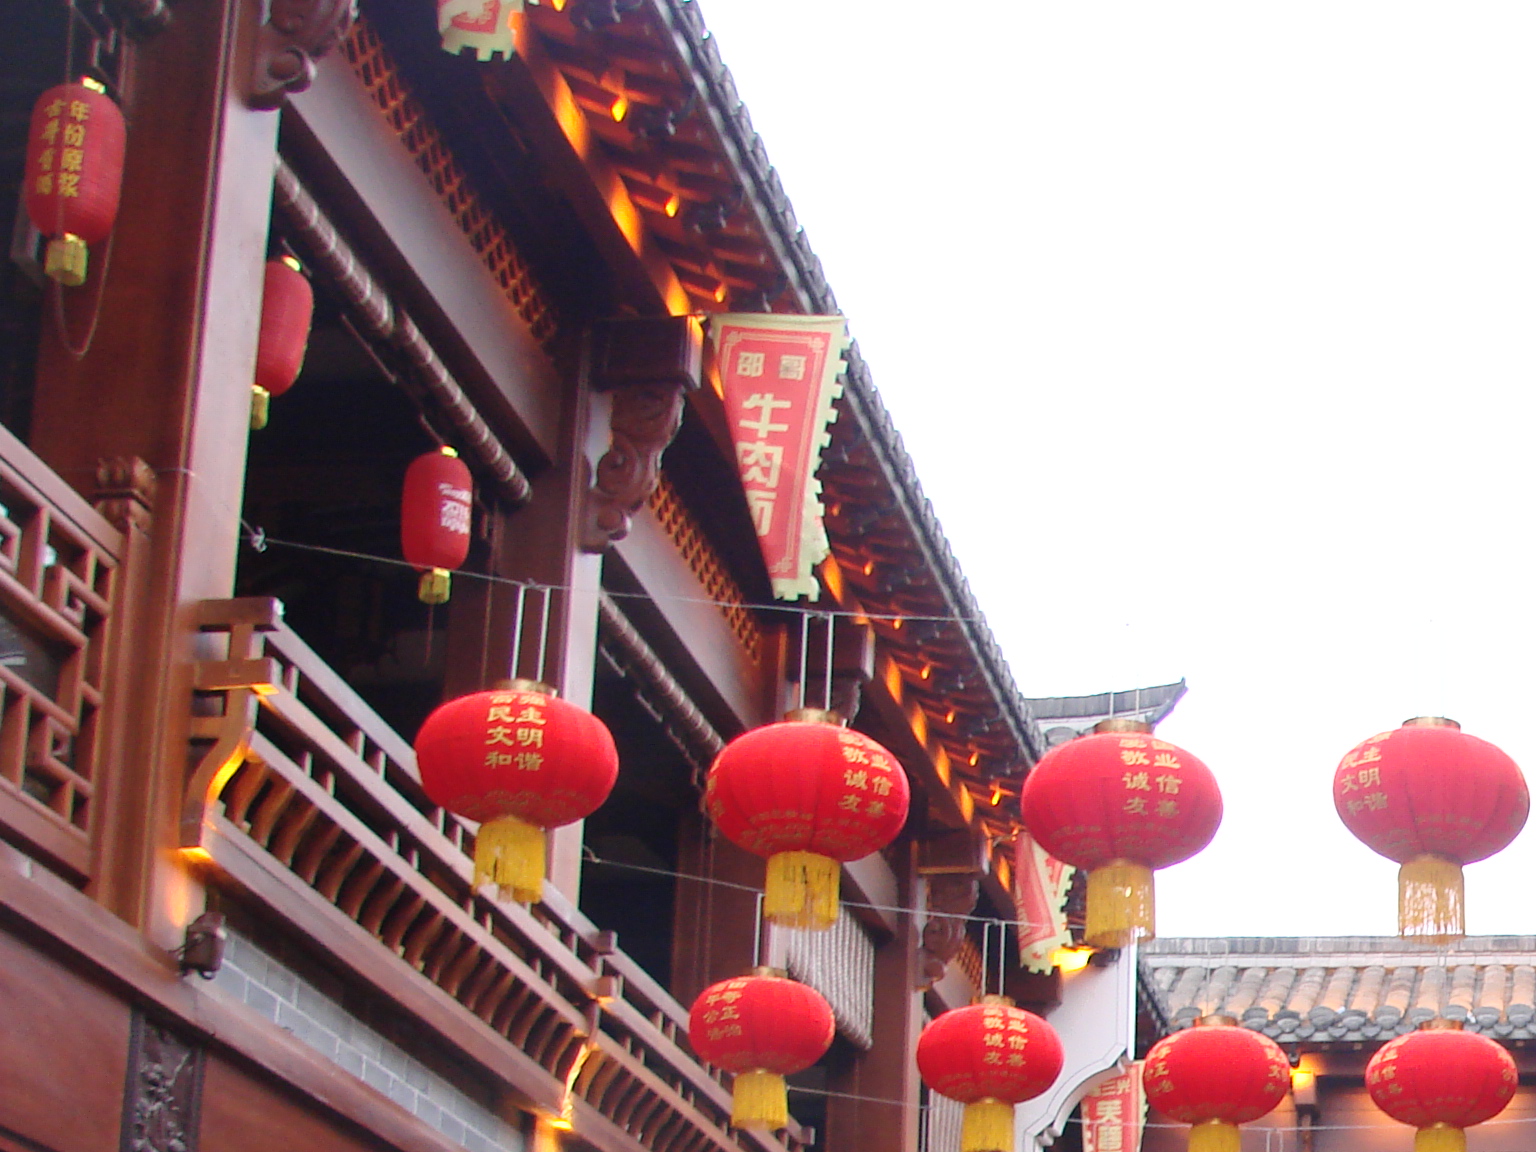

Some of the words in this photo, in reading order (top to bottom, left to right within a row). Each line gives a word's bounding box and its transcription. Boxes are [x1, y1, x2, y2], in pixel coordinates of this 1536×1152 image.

[487, 705, 546, 725] 民主
[485, 726, 543, 748] 文明
[485, 751, 545, 771] 和谐
[1121, 750, 1181, 769] 敬业
[844, 769, 893, 796] 诚信
[1122, 771, 1182, 794] 诚信
[1123, 796, 1180, 818] 友善
